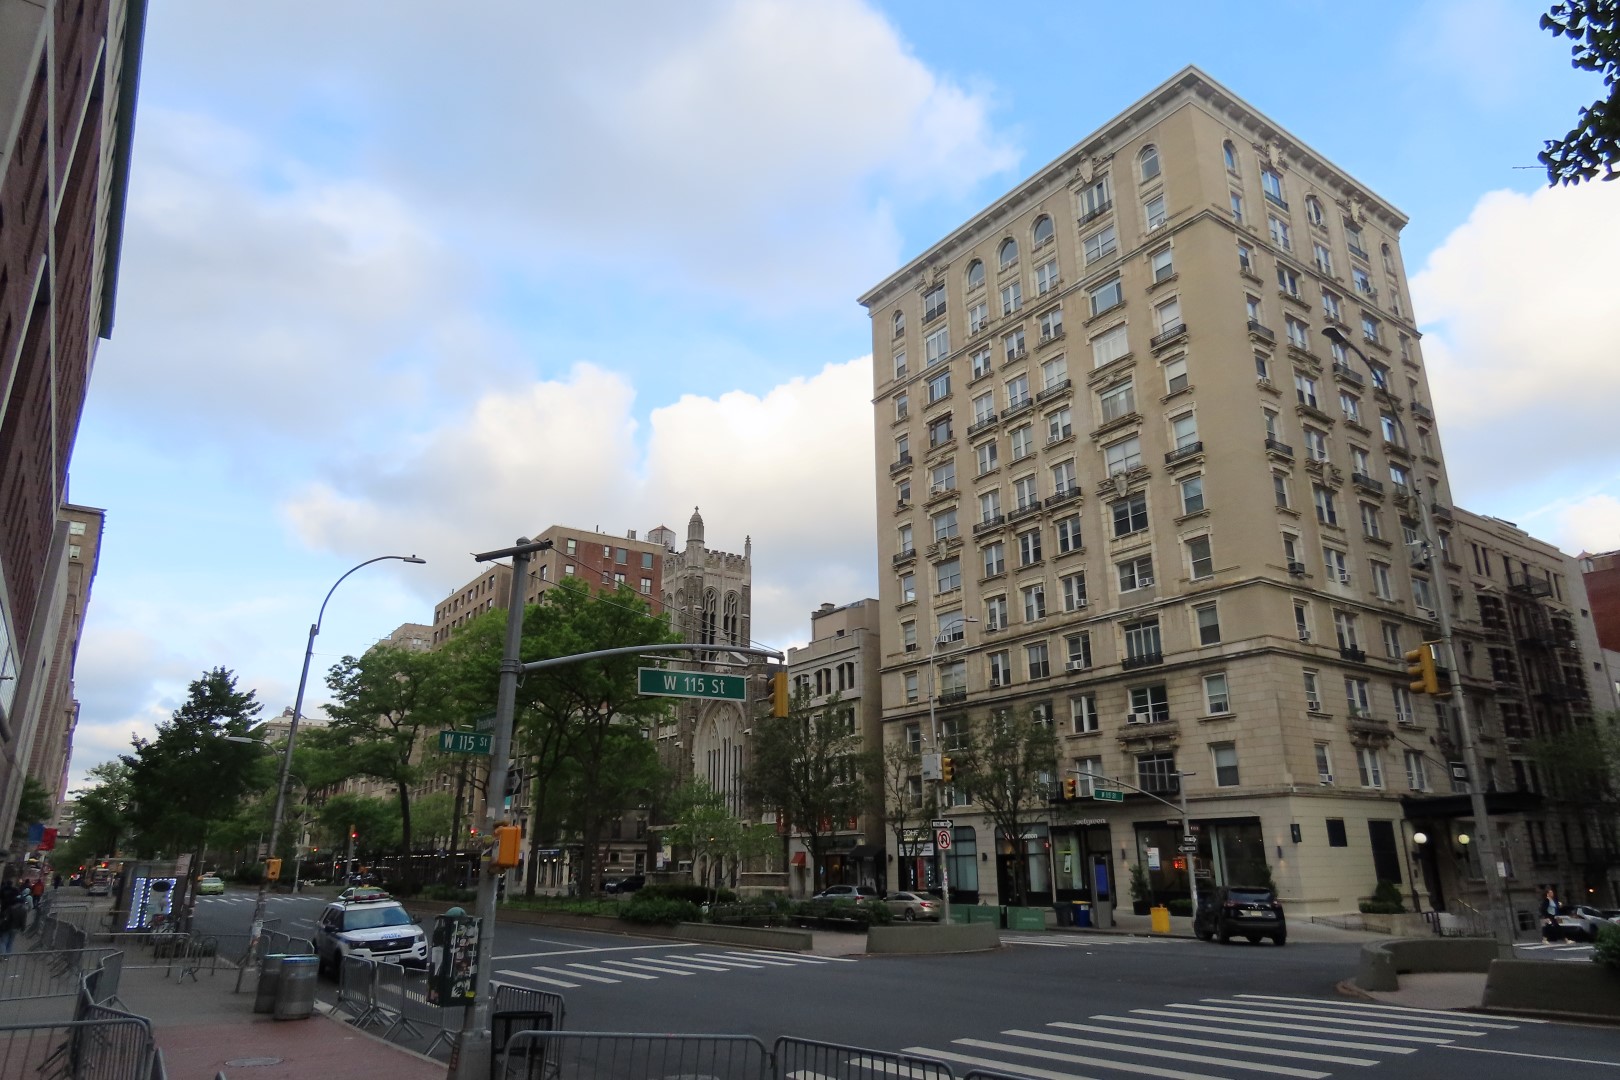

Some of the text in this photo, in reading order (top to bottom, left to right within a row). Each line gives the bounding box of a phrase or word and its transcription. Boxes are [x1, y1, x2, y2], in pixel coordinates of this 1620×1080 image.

[663, 675, 725, 694] W 115 St
[444, 733, 488, 751] W 115 St
